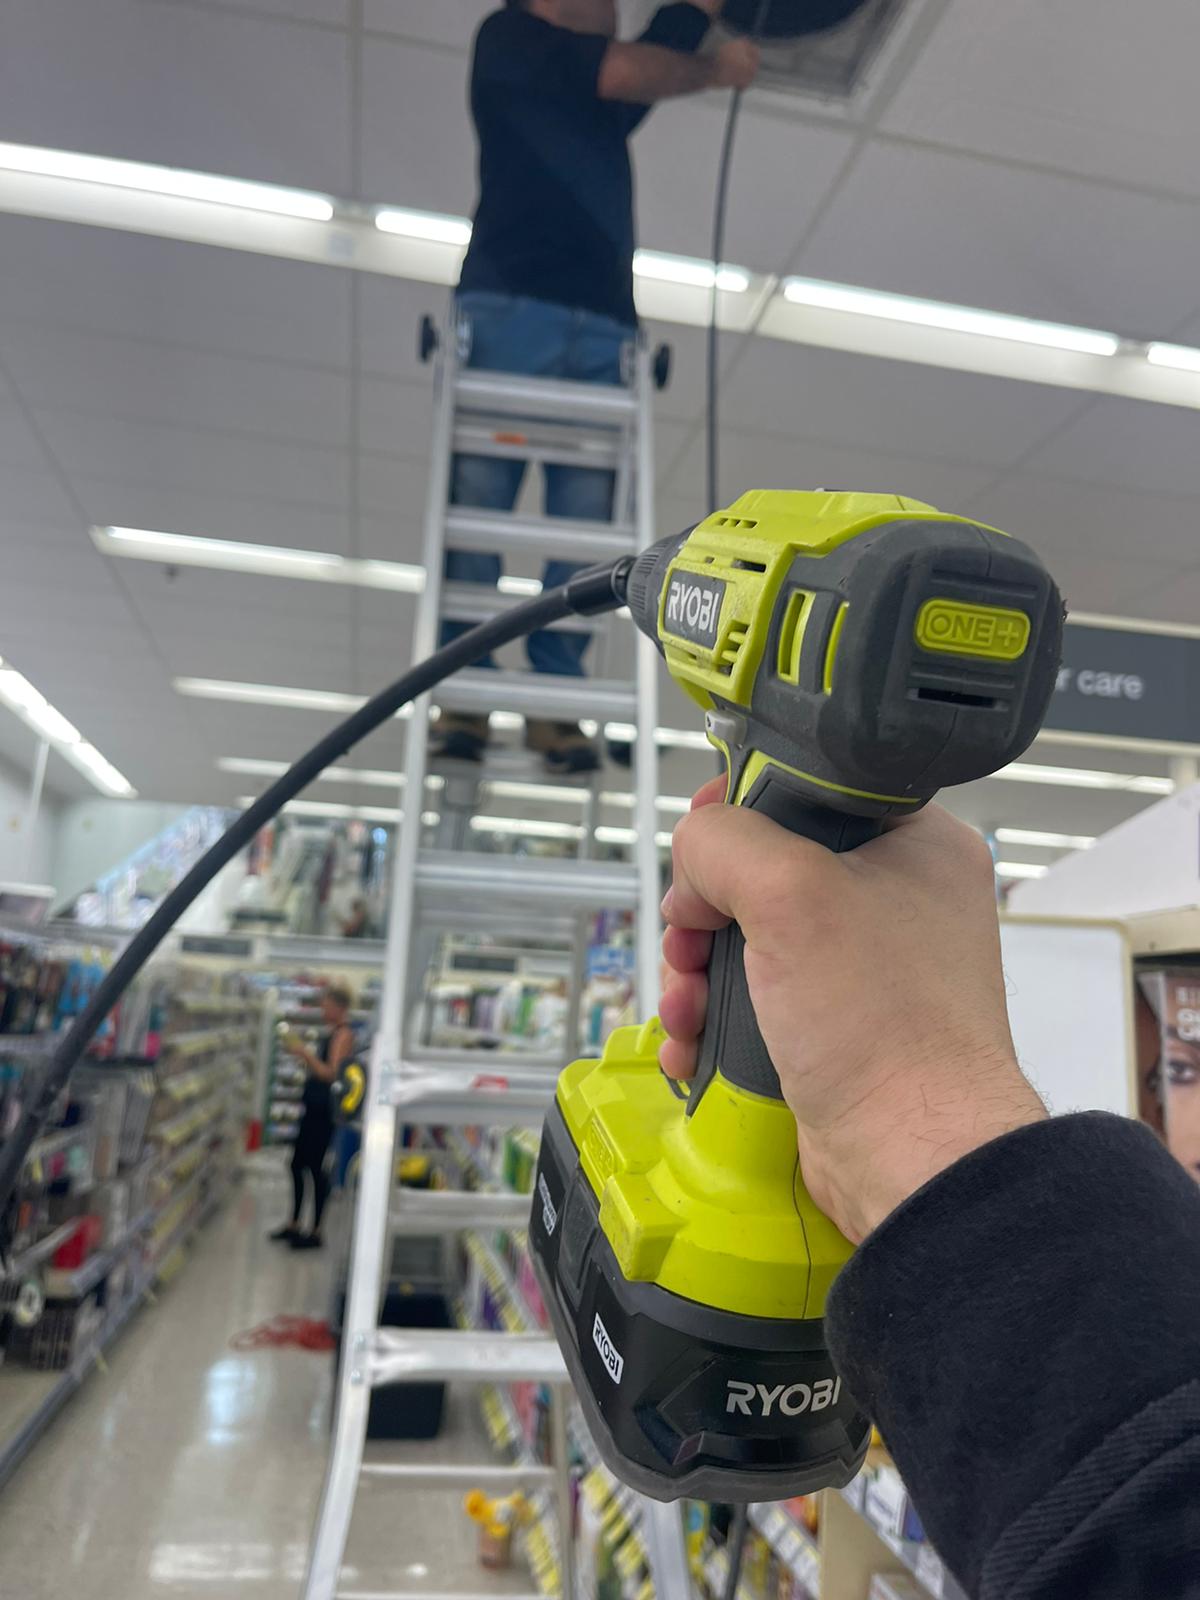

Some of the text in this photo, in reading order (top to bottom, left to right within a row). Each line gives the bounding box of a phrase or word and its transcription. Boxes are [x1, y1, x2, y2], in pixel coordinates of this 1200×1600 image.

[668, 581, 719, 633] RYOBI
[929, 613, 1020, 648] ONE+
[1077, 670, 1143, 700] care
[595, 1320, 620, 1377] RYOBI
[726, 1375, 841, 1416] RYOBI
